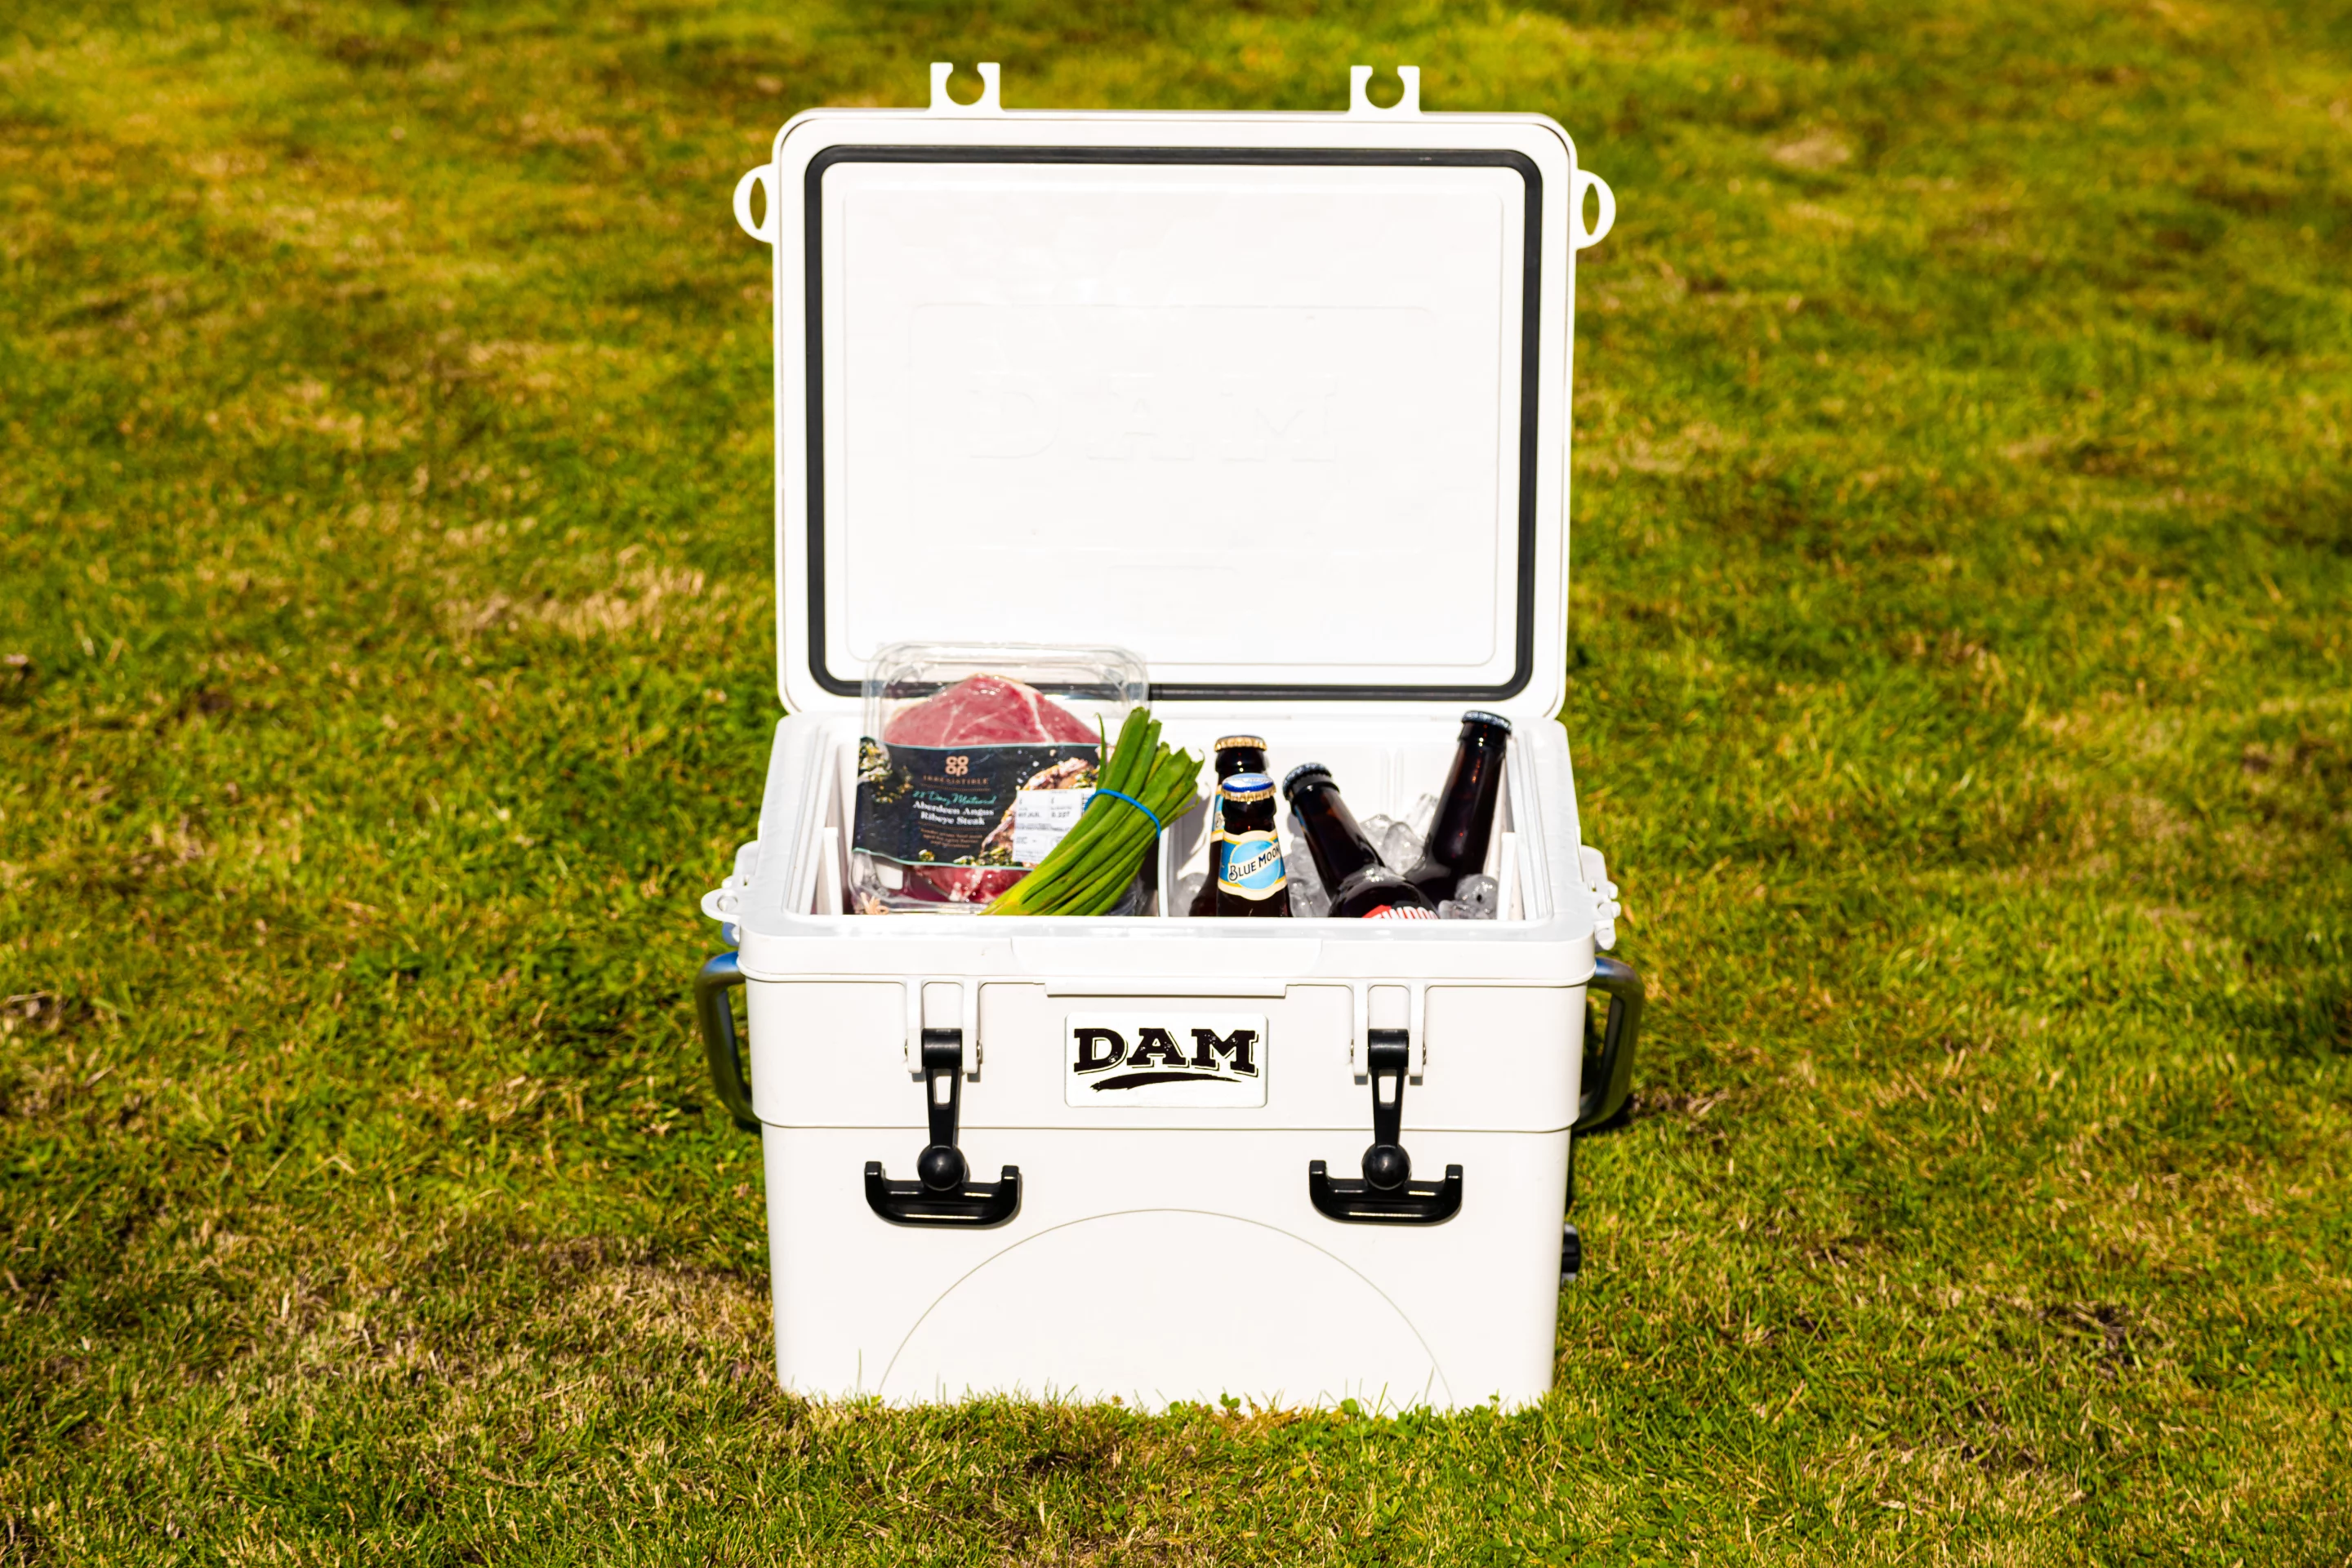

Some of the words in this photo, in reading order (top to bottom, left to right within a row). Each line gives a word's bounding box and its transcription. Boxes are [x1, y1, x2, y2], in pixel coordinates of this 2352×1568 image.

[965, 370, 1337, 462] DAM
[923, 774, 989, 785] IRRESISTIBLE
[912, 800, 960, 814] Aberdeen
[962, 808, 994, 816] Angus
[920, 811, 954, 825] Ribeye
[956, 816, 985, 825] Steak
[1229, 865, 1256, 881] BLUE
[1073, 1027, 1258, 1077] DAM
